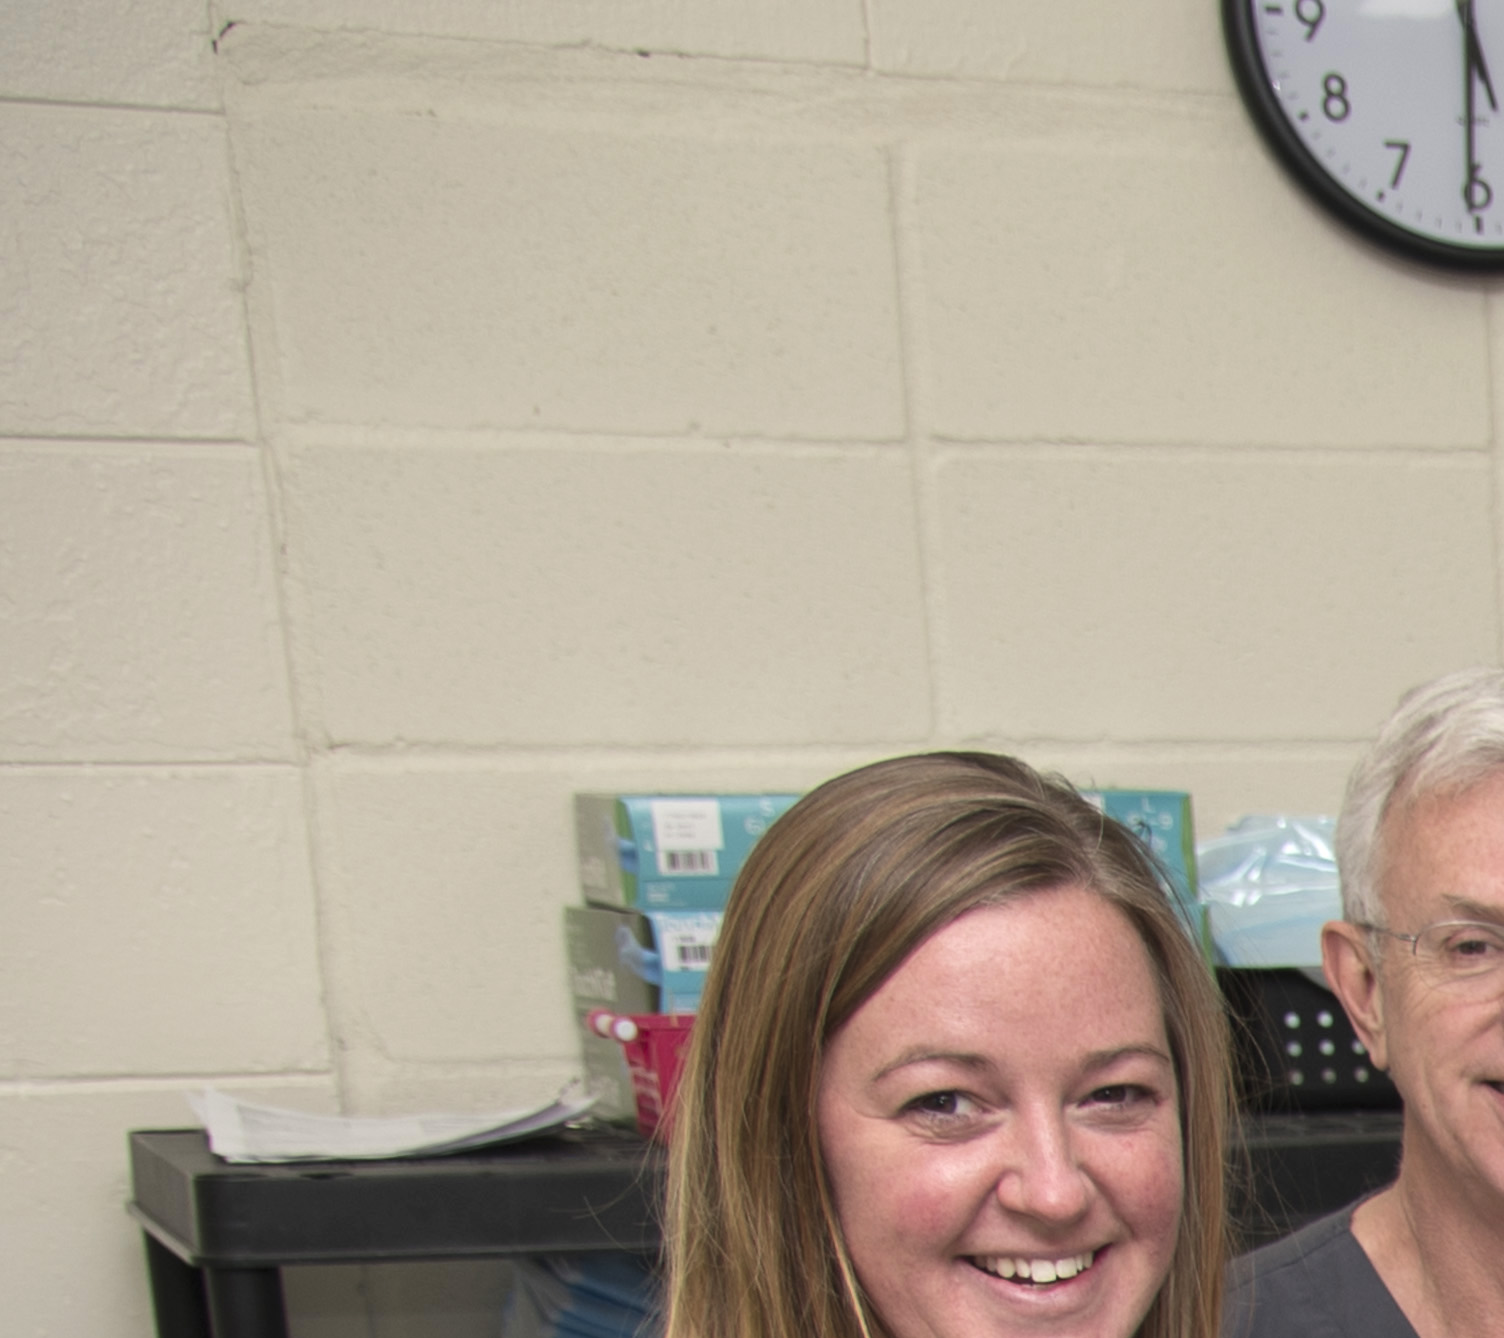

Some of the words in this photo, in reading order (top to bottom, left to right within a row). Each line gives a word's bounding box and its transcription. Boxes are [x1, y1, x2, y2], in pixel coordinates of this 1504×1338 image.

[1294, 0, 1326, 42] 9
[1321, 72, 1352, 122] 8
[1383, 140, 1411, 190] 7
[1463, 163, 1493, 213] 6
